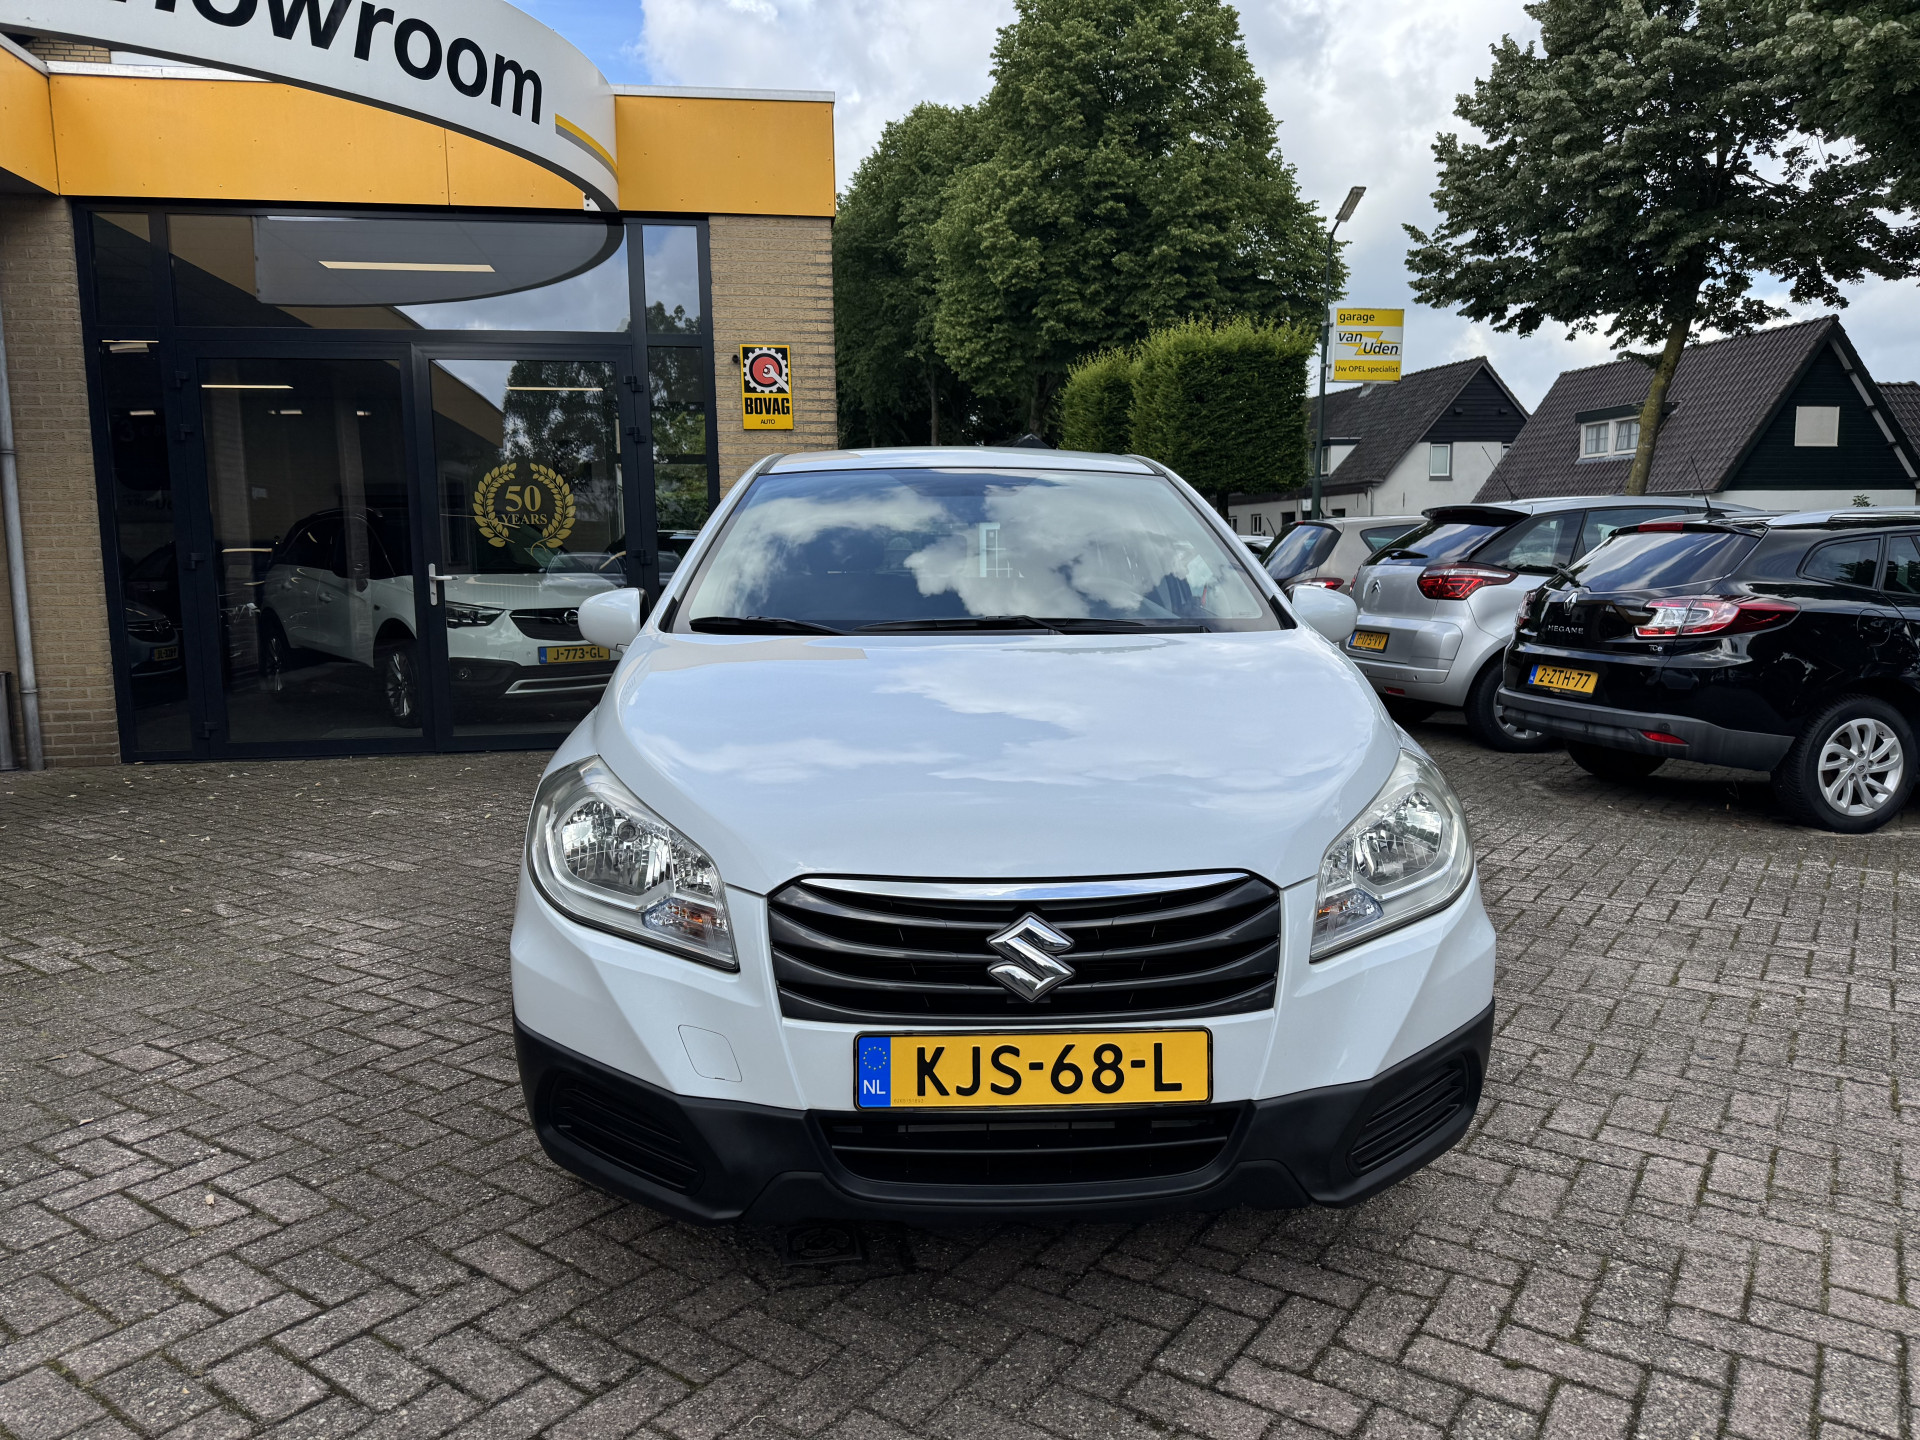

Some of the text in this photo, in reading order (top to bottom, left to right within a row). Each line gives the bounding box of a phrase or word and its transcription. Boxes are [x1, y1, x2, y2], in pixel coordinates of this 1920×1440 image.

[1339, 313, 1375, 324] garage
[1338, 332, 1399, 355] van Uden
[1367, 365, 1399, 374] specialist
[744, 397, 790, 415] BOVAG
[505, 485, 542, 512] 50
[501, 513, 548, 525] YEARS
[1547, 624, 1584, 635] MEGANE
[553, 646, 604, 662] J-773-GL
[1538, 668, 1592, 689] 2-ZTH-77
[916, 1042, 1183, 1097] KJS-68-L
[863, 1079, 886, 1095] NL
